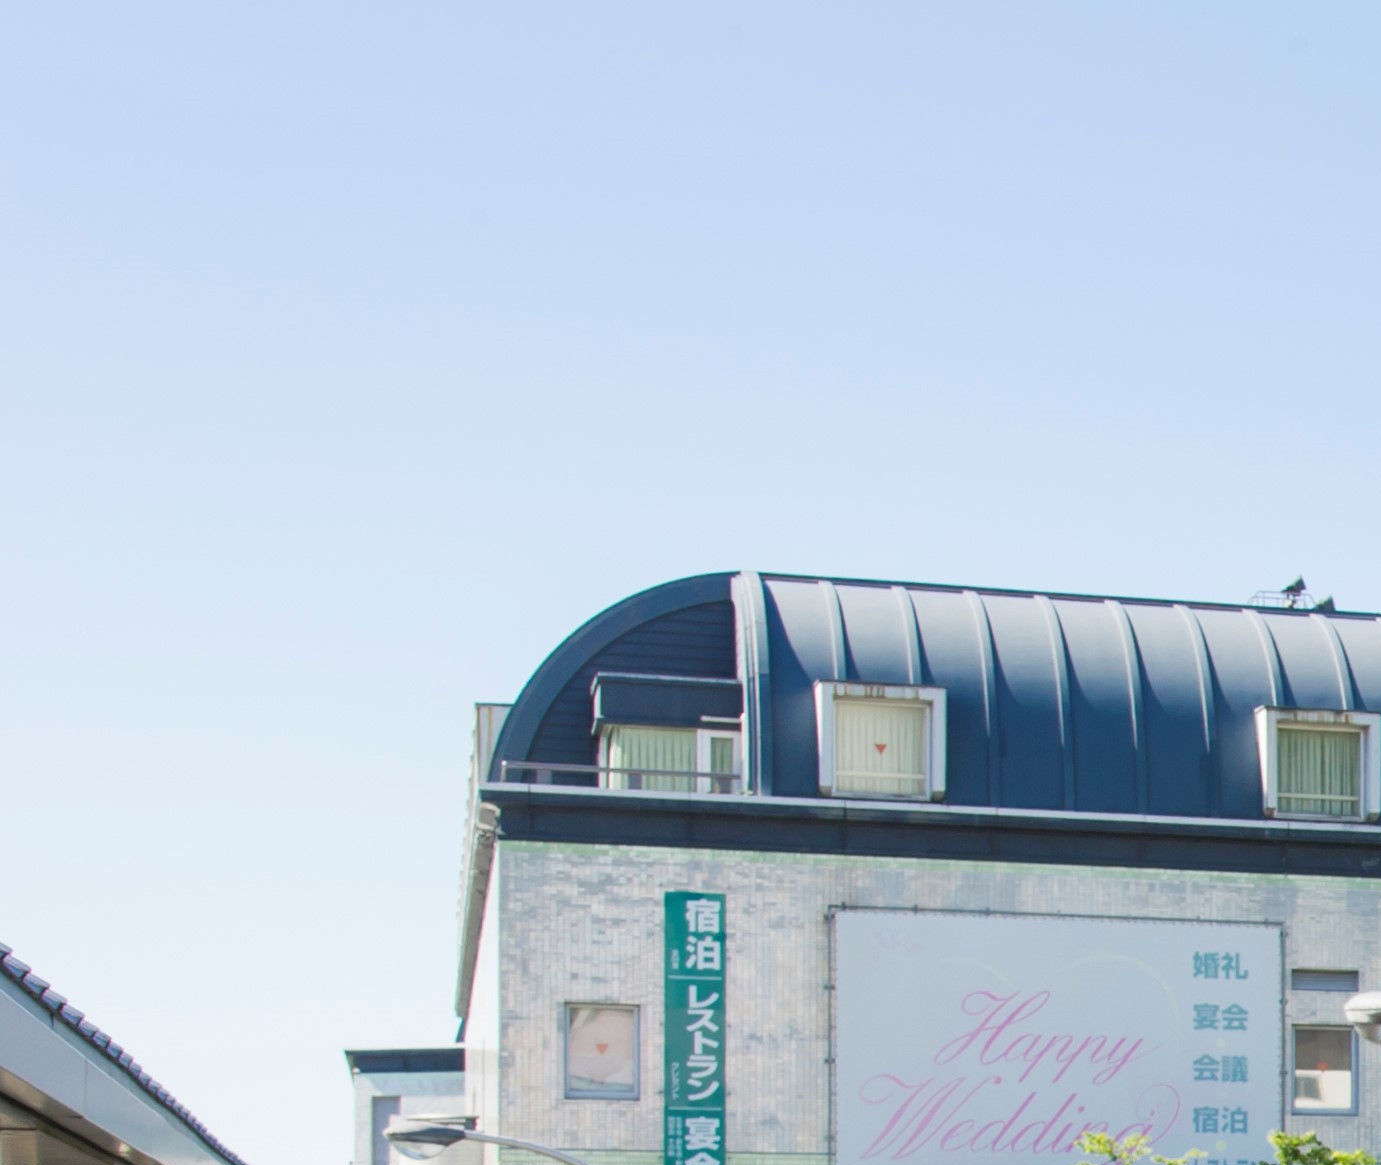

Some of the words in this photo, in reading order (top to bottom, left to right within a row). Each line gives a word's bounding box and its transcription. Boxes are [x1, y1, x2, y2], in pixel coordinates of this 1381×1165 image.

[685, 898, 722, 971] 宿泊
[1192, 952, 1249, 981] 婚礼
[1192, 1003, 1248, 1031] 宴会
[685, 984, 720, 1101] レストラン
[933, 989, 1150, 1085] Happy
[1192, 1054, 1248, 1083] 会議
[1192, 1106, 1248, 1135] 宿泊
